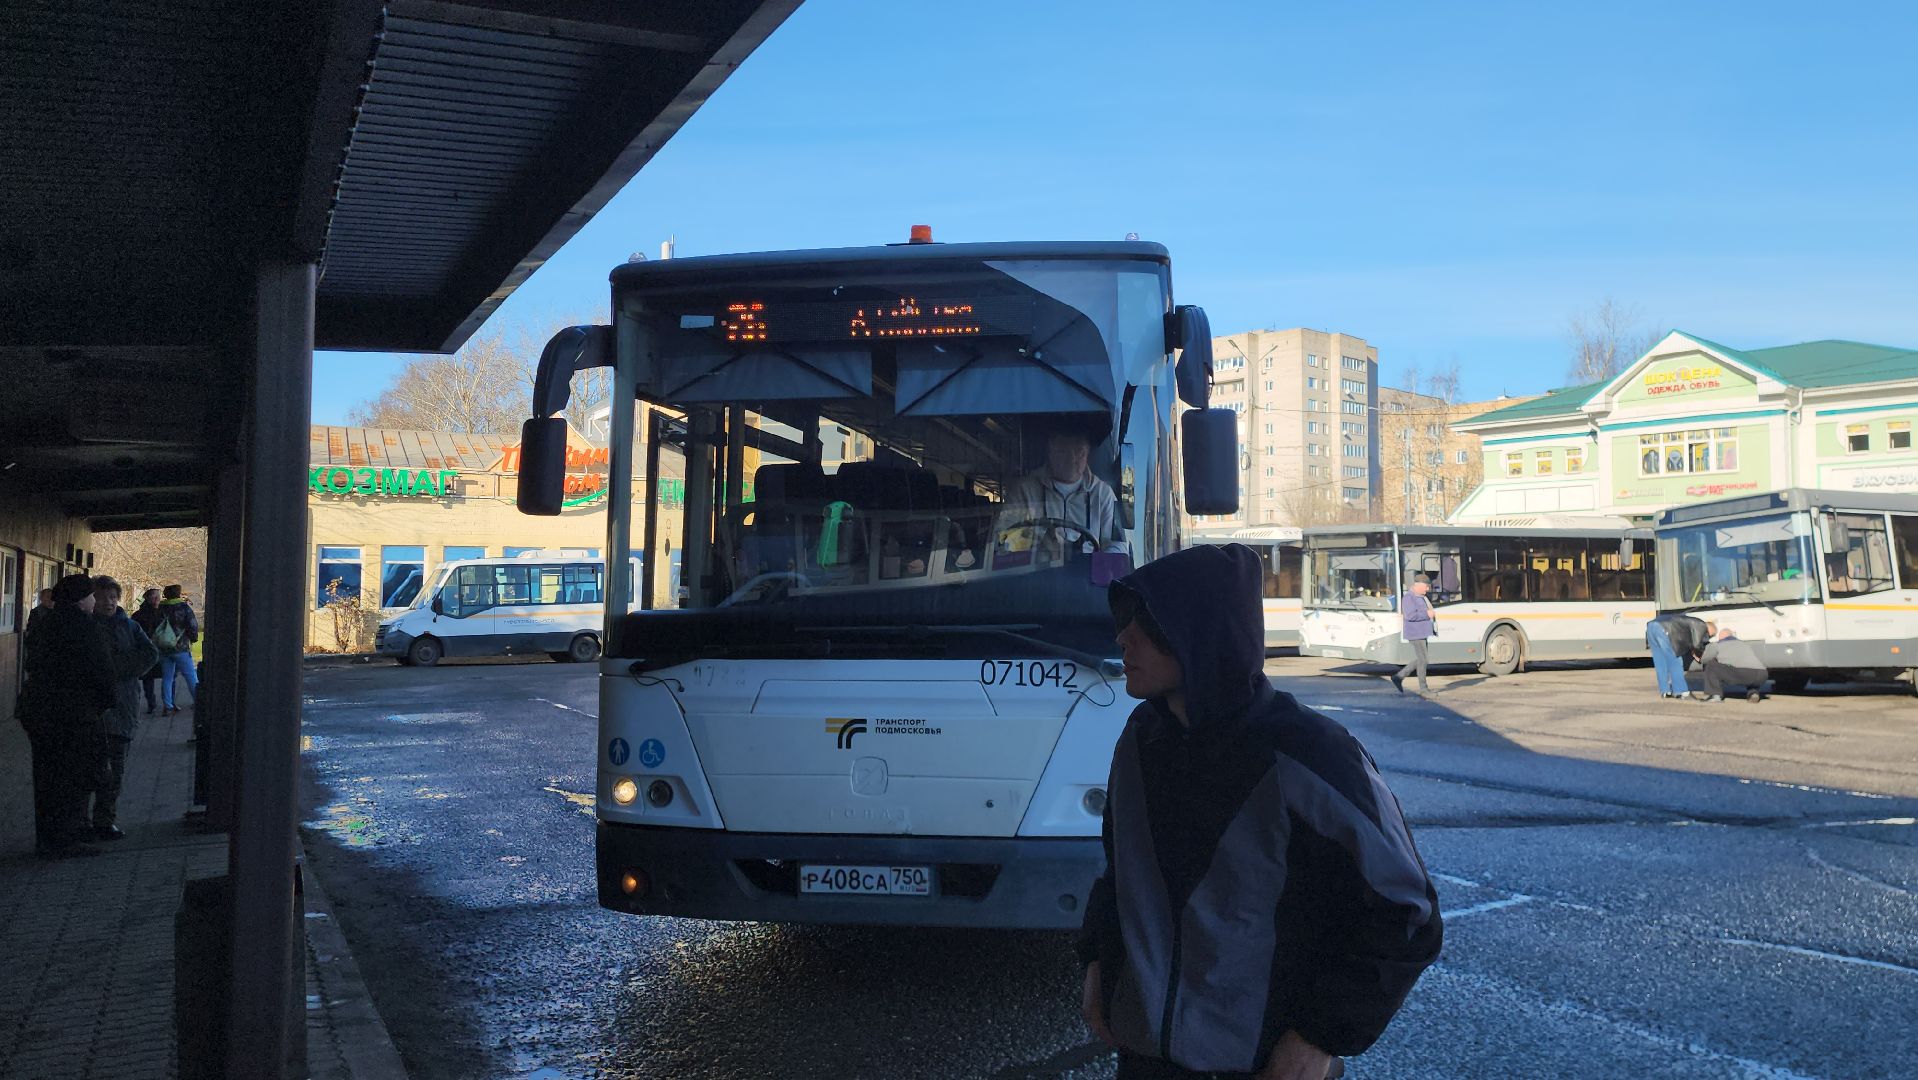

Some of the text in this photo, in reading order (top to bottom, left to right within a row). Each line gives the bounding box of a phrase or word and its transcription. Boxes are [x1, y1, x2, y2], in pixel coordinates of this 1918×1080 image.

[1648, 380, 1720, 395] ОДЕЖДА ОБУВЬ
[981, 660, 1078, 689] 071042
[875, 718, 927, 726] ТРАНСПОРТ
[875, 726, 942, 735] ПОДМОСКОВЬЯ
